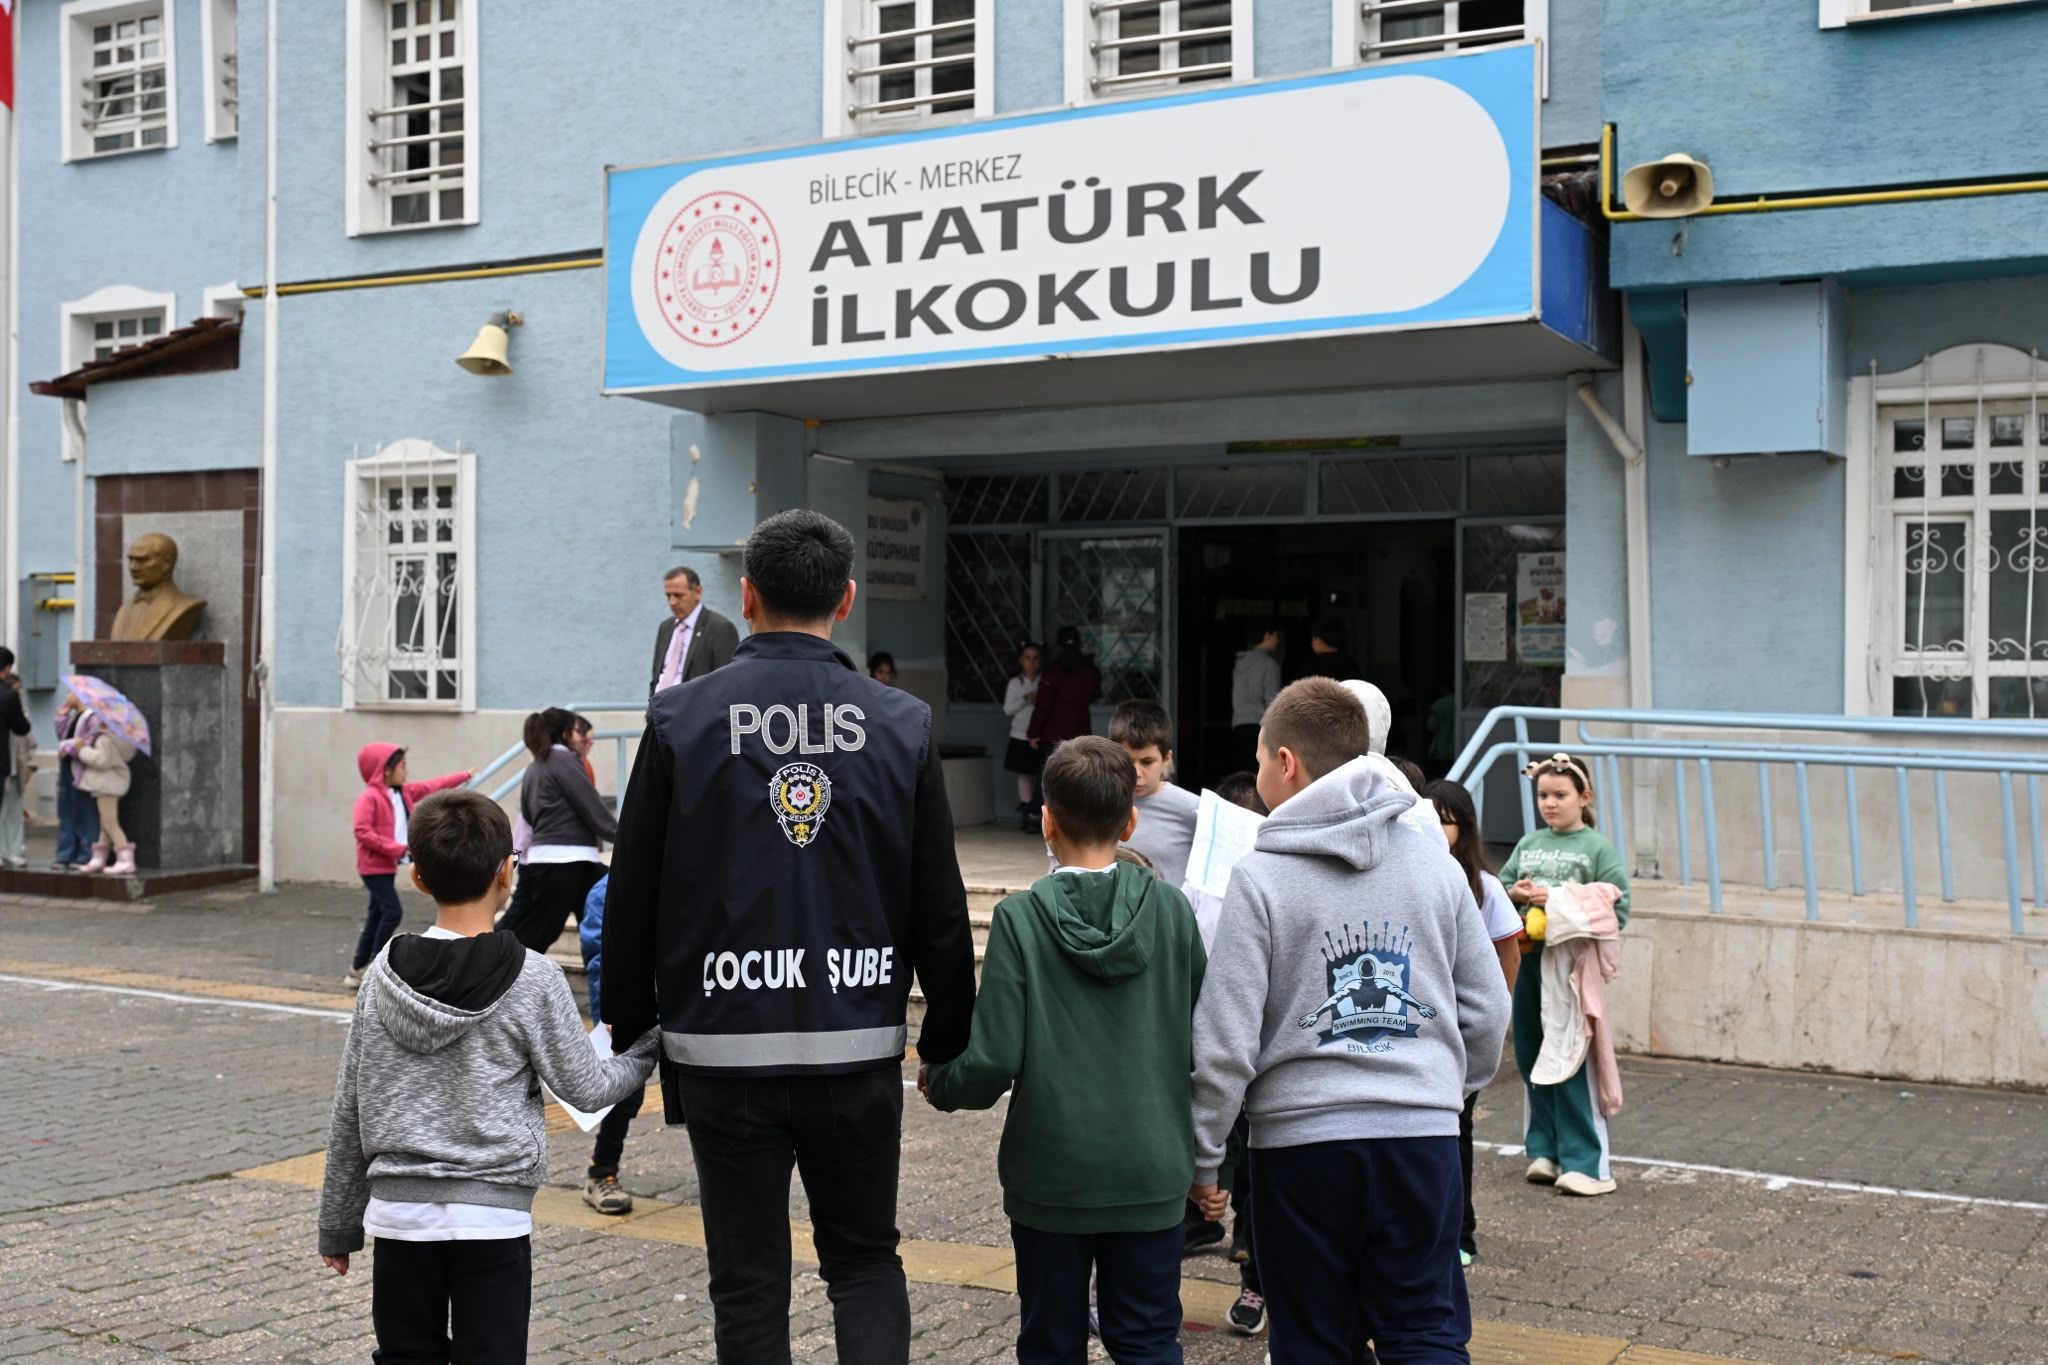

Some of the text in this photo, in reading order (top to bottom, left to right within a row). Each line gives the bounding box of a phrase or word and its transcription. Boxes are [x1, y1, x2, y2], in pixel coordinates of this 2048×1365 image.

[809, 167, 898, 204] BİLECİK
[919, 153, 1022, 191] MERKEZ
[808, 168, 1266, 273] ATATÜRK
[811, 245, 1322, 347] İLKOKULU
[703, 946, 894, 997] ÇOCUK ŞUBE
[1339, 969, 1395, 981] SINCE 2015
[1333, 1017, 1406, 1031] SWIMMING TEAM
